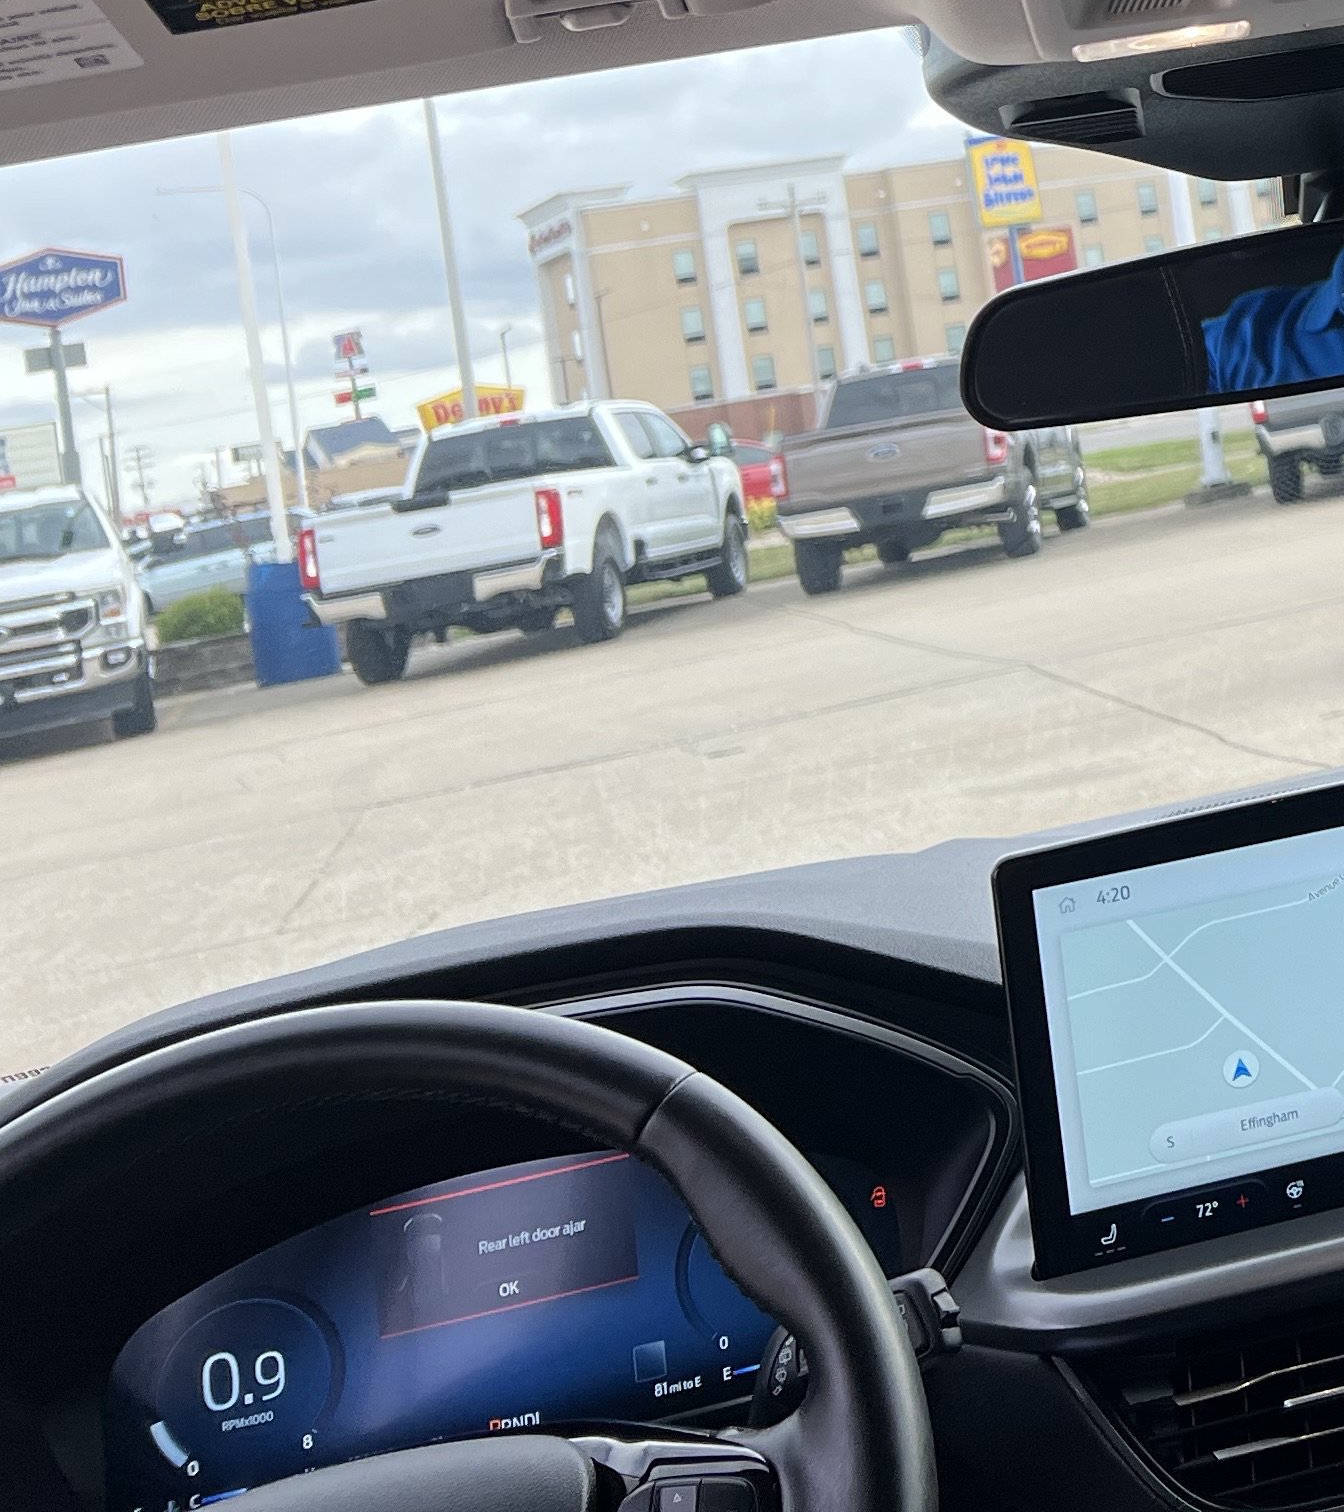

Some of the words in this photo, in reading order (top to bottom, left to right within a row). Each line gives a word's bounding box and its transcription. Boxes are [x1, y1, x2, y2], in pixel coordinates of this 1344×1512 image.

[195, 0, 278, 22] SOBRE
[0, 267, 114, 303] Hampton
[431, 391, 519, 426] Deny's
[1095, 885, 1131, 905] 4:20
[1308, 878, 1340, 902] Avenue
[1240, 1107, 1299, 1133] Effingham
[1166, 1135, 1176, 1149] S
[478, 1237, 508, 1255] Rear
[508, 1231, 531, 1248] left
[531, 1226, 562, 1242] door
[562, 1219, 587, 1236] ajar
[498, 1280, 521, 1297] OK
[202, 1350, 287, 1411] 0.9
[722, 1366, 732, 1381] E
[654, 1382, 668, 1397] 81
[669, 1381, 682, 1394] mi
[683, 1379, 694, 1390] to
[221, 1410, 275, 1432] RPMx1000
[302, 1434, 314, 1450] 8
[186, 1459, 200, 1477] 0
